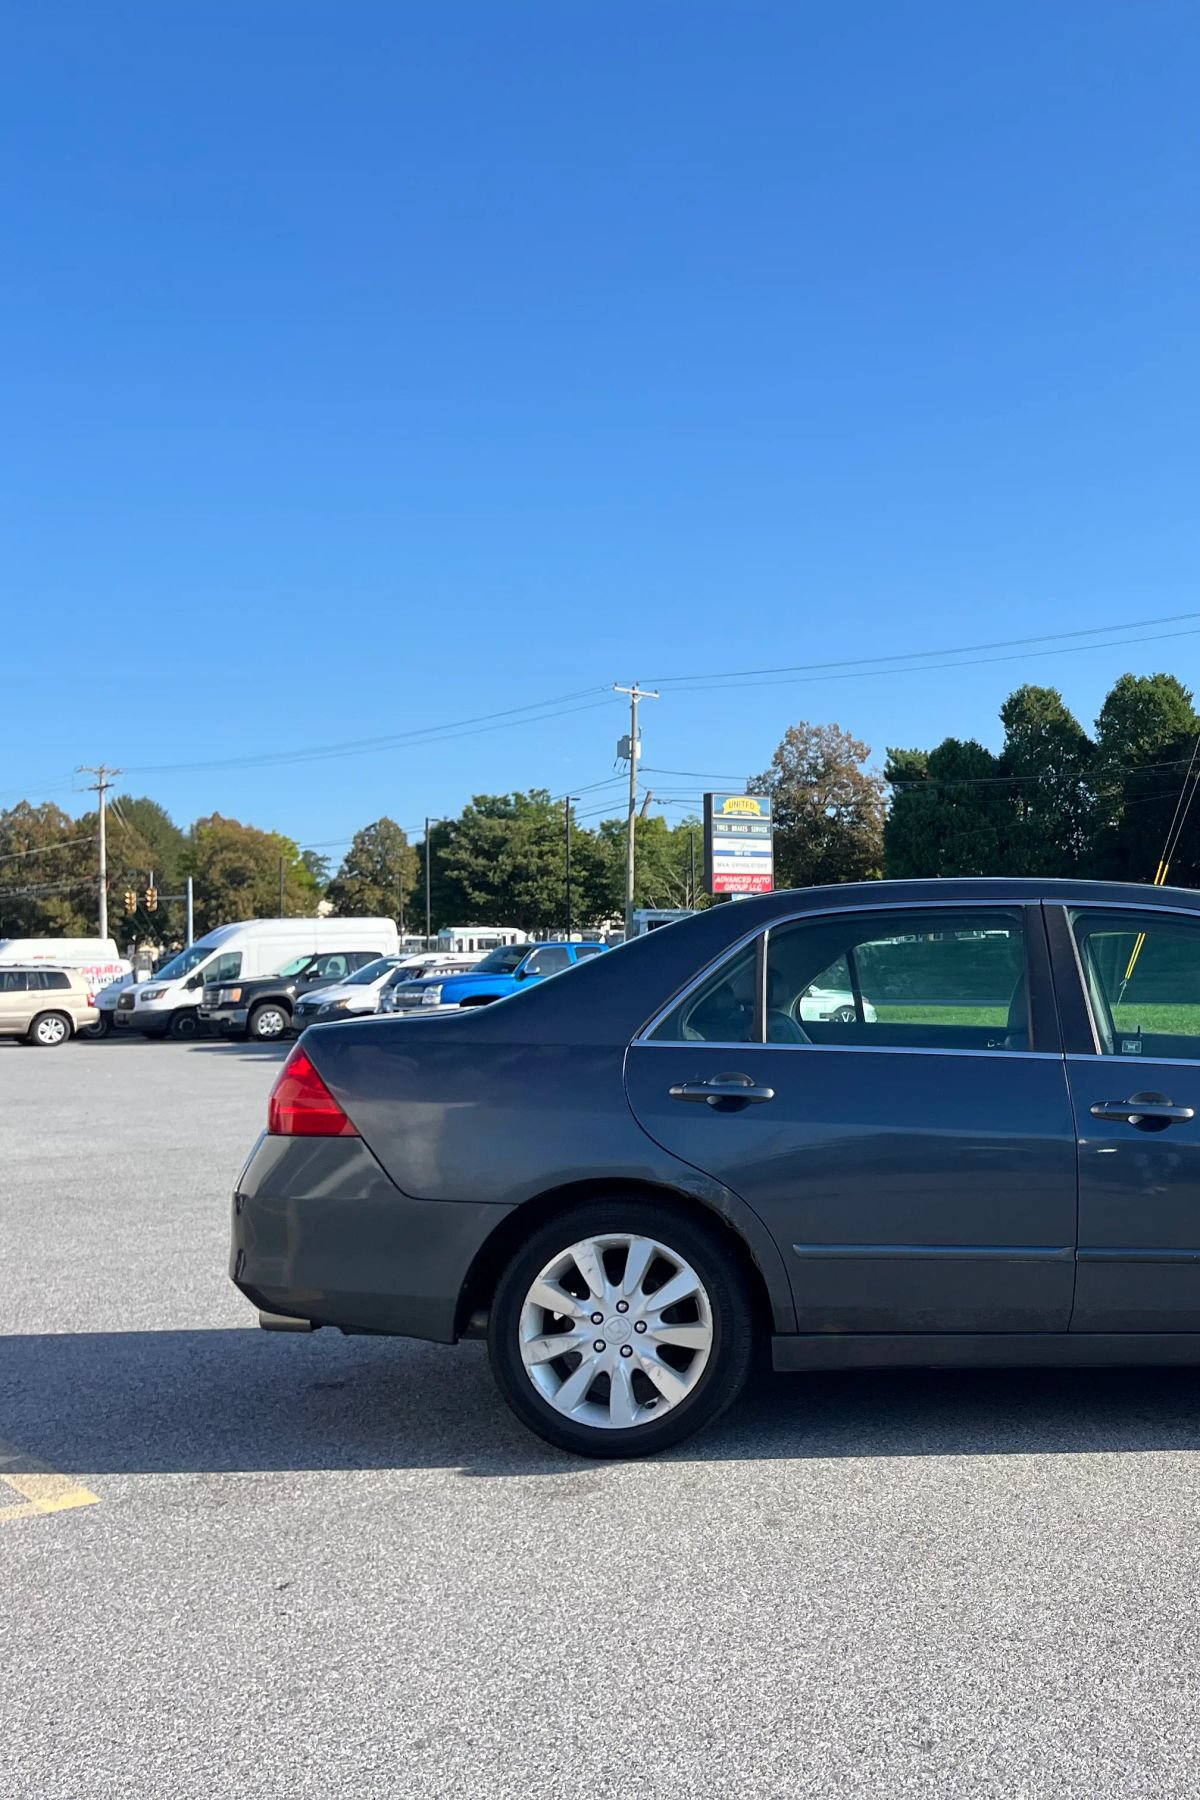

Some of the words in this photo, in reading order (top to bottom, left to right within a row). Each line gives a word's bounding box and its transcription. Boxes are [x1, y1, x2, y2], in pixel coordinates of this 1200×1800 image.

[728, 799, 755, 810] UNITED
[731, 824, 748, 833] BRAKES
[751, 825, 768, 833] SERVICE
[715, 875, 752, 883] ADVANCED
[752, 876, 769, 884] AUTO
[724, 883, 748, 891] GROUP
[83, 964, 123, 976] squito
